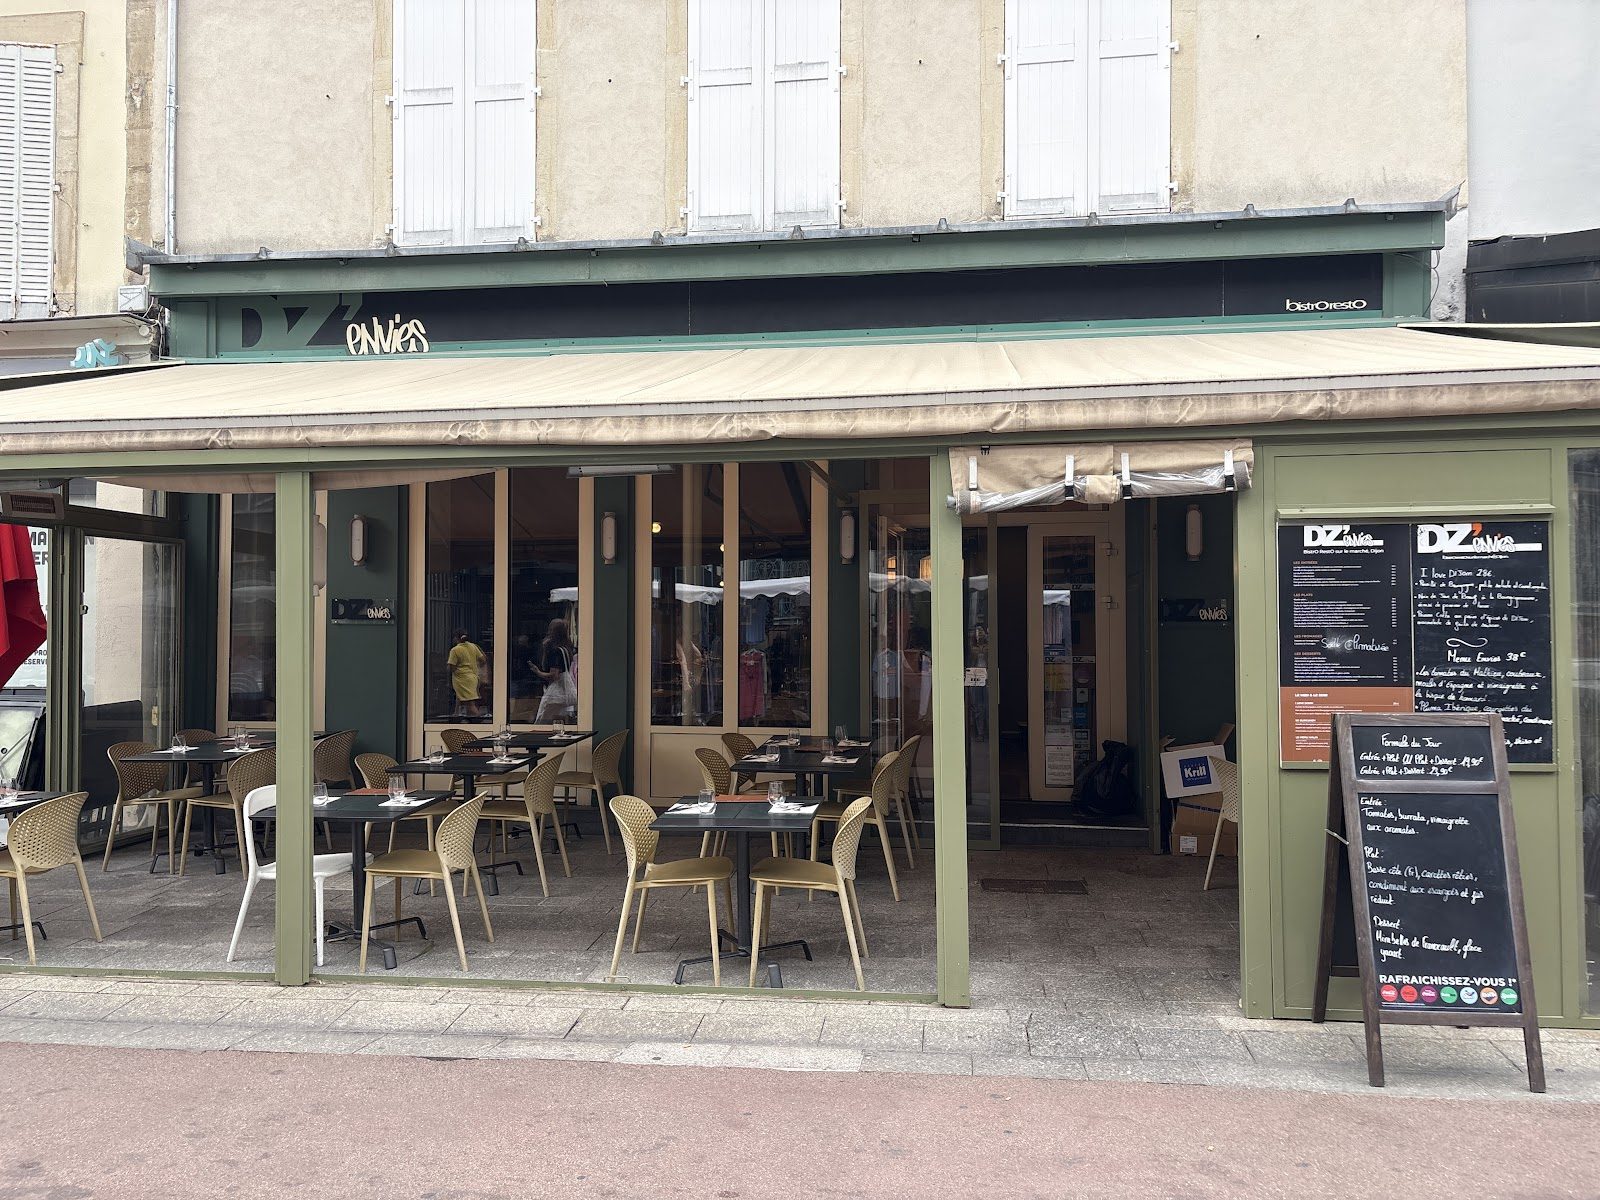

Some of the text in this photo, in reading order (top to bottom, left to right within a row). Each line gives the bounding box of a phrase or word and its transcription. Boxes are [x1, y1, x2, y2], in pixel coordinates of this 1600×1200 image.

[1432, 568, 1446, 578] love
[1410, 737, 1421, 748] du
[1184, 765, 1207, 778] Krill
